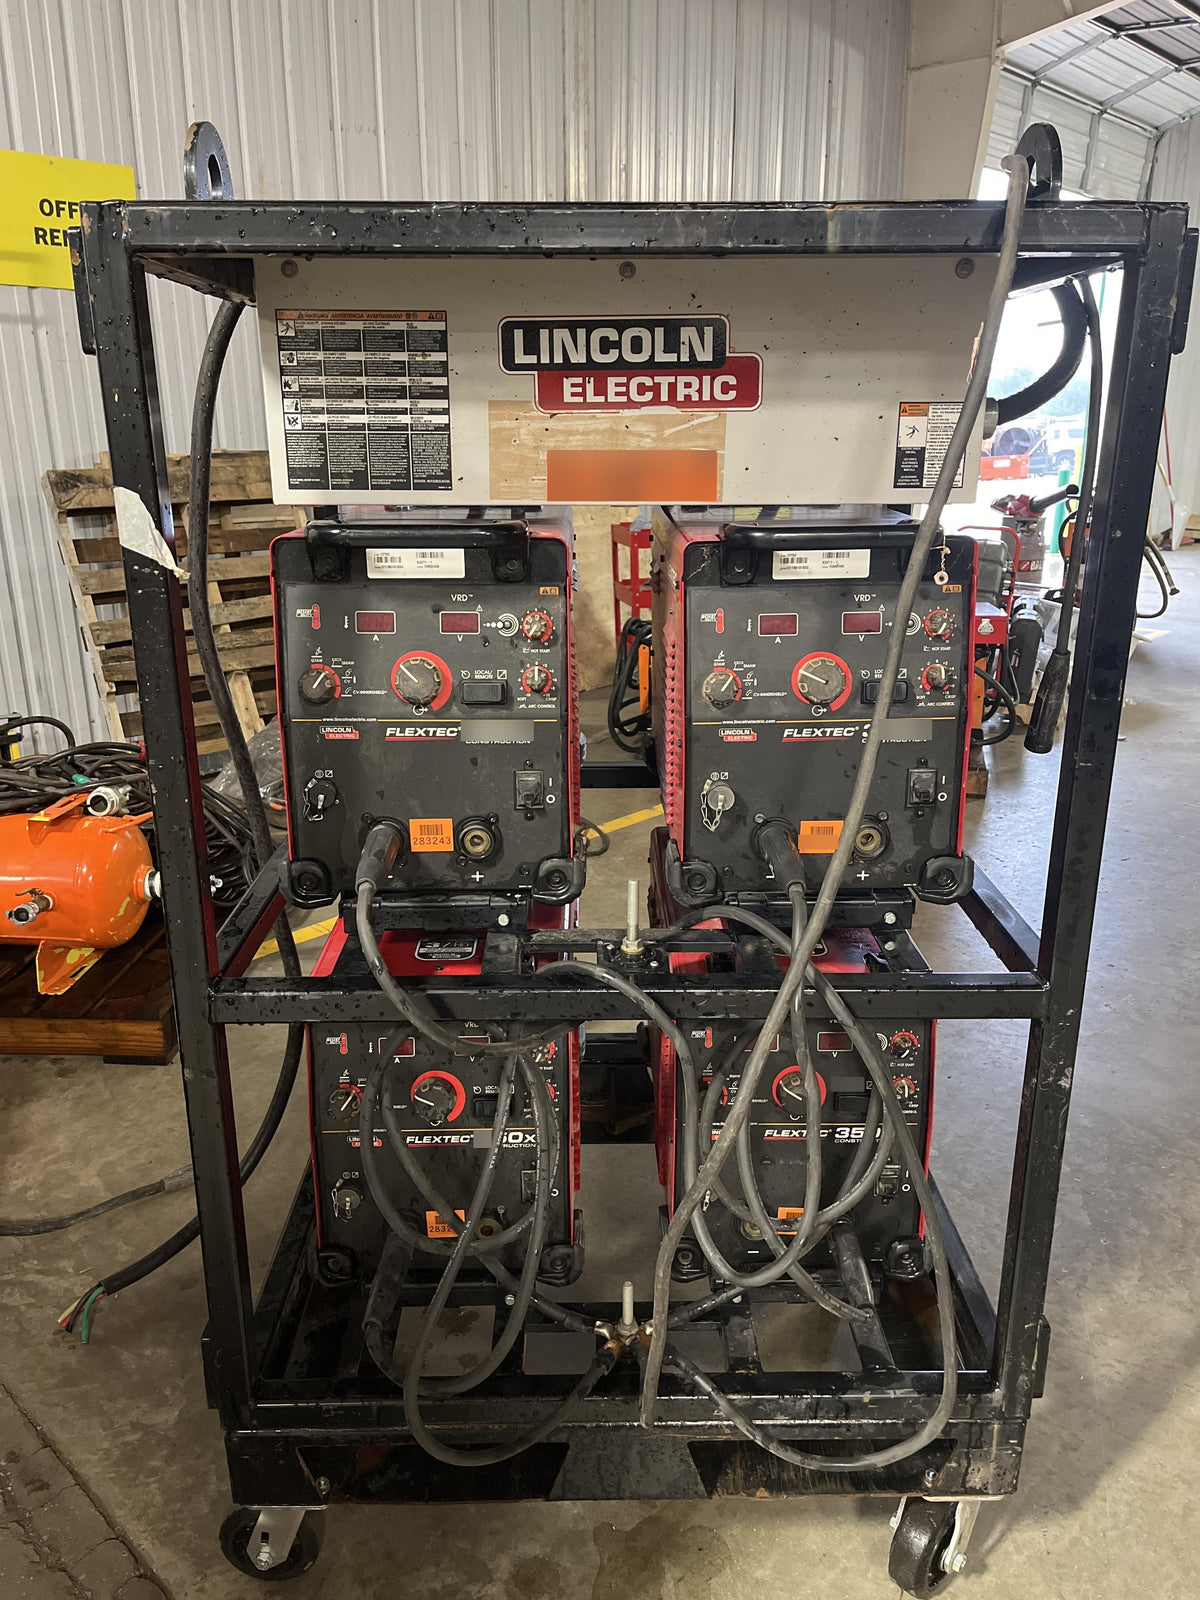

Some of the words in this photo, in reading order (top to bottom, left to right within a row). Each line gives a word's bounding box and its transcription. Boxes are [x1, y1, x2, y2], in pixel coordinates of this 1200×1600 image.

[513, 327, 713, 363] LINCOLN
[563, 375, 737, 403] ELECTRIC
[412, 836, 451, 846] 283243
